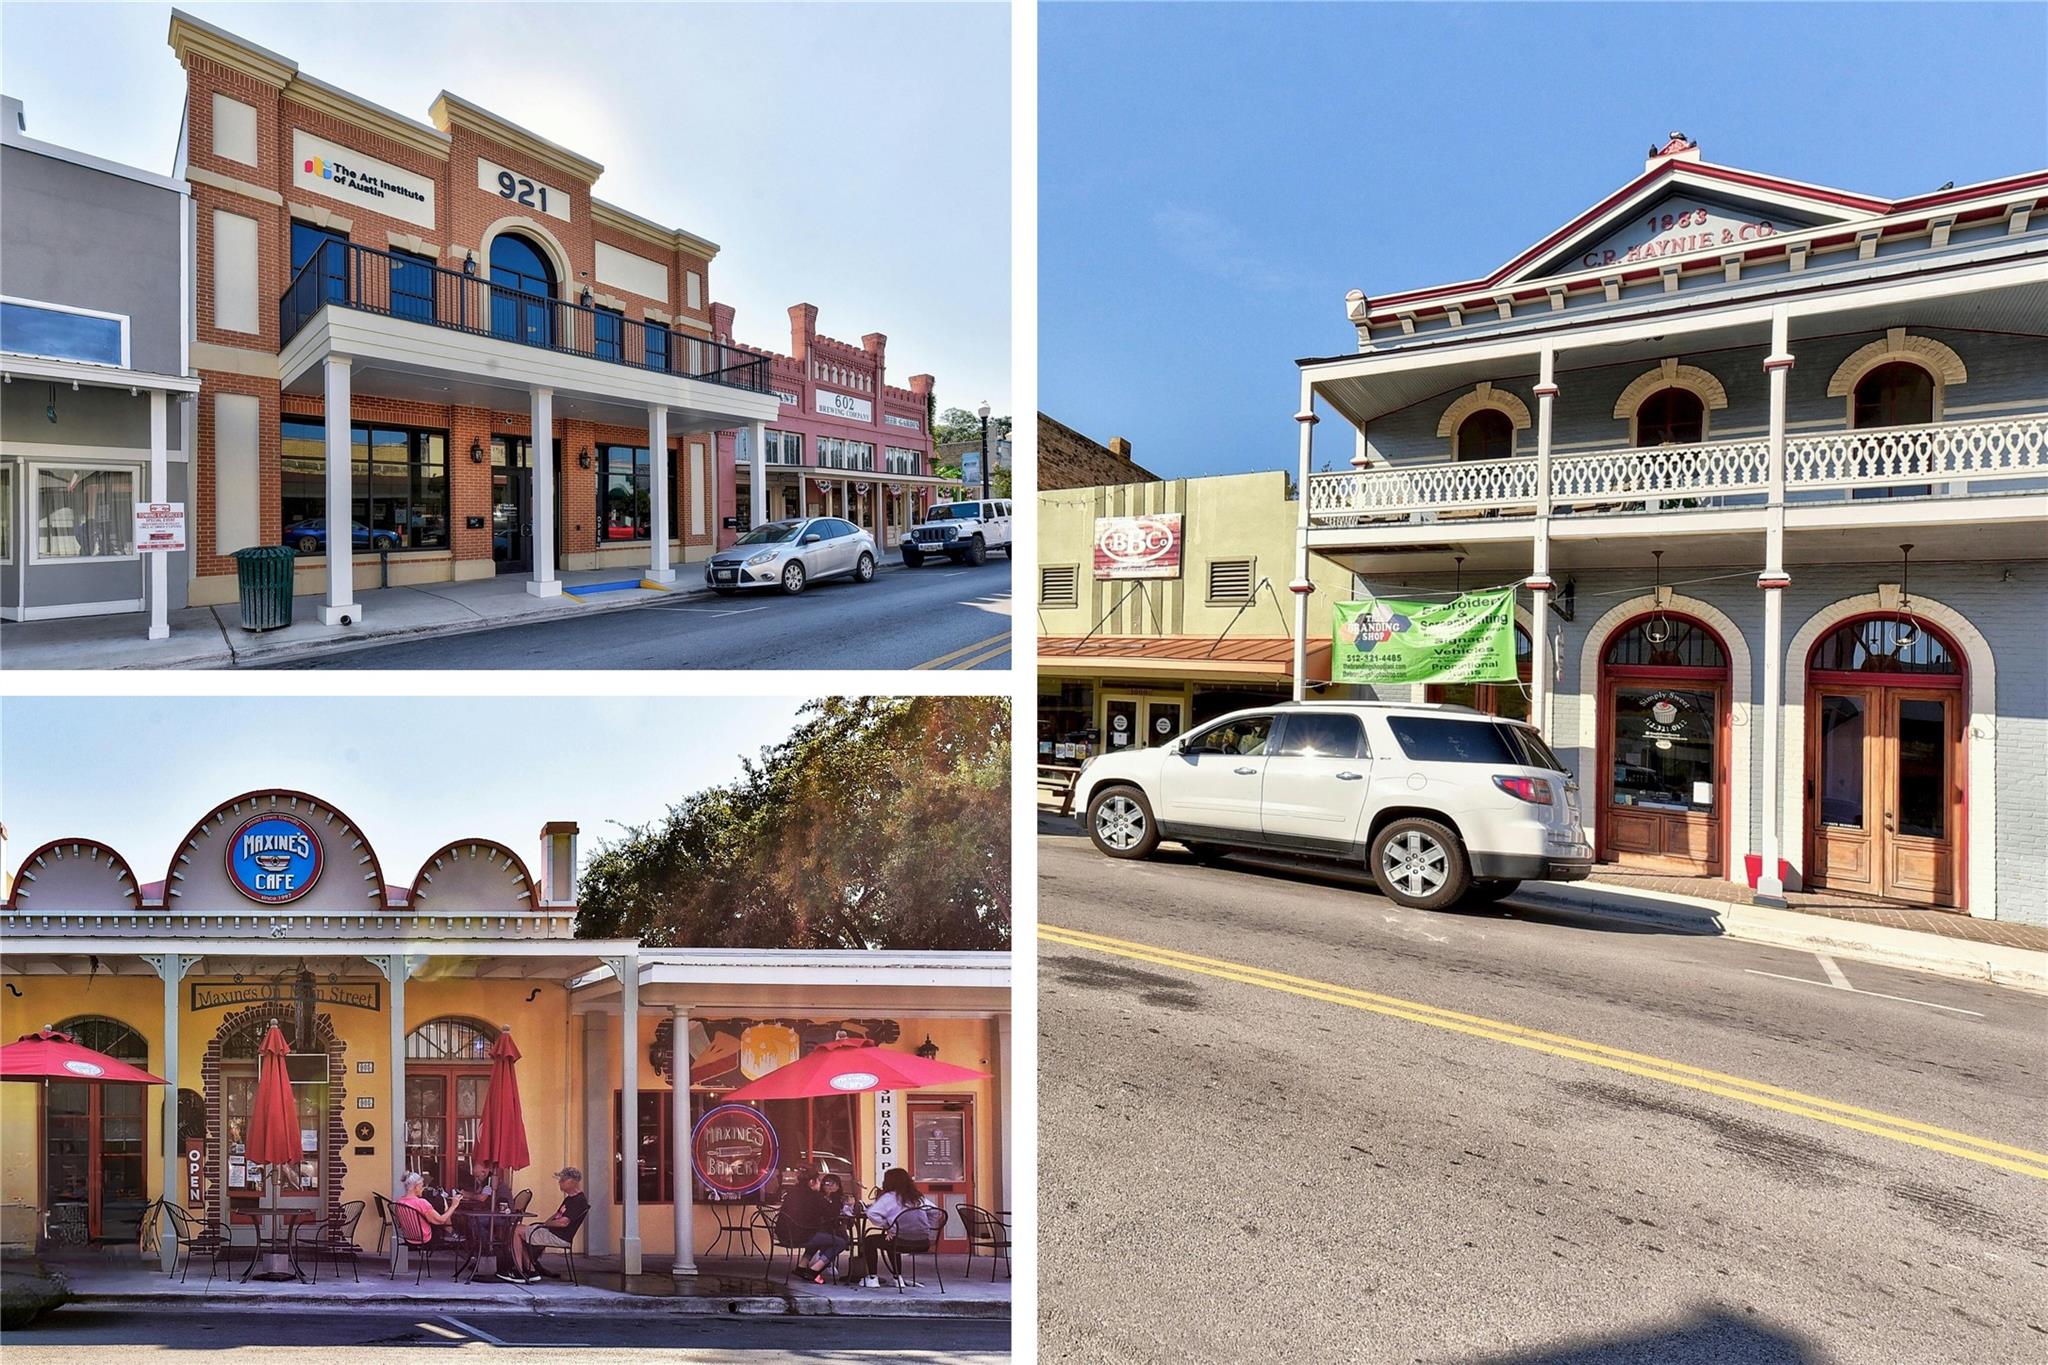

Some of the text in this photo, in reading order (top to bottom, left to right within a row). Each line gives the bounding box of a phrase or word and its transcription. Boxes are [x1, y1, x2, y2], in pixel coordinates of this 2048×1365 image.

[333, 163, 425, 202] The Art Institute
[333, 175, 385, 198] of Austin
[498, 171, 547, 213] 921
[1627, 232, 1714, 261] HAYNIE
[1721, 228, 1734, 244] &
[819, 404, 870, 421] BREWING COMPANY
[835, 394, 854, 411] 602
[898, 418, 919, 428] GARDEN
[1362, 632, 1385, 641] SHOP
[1346, 654, 1402, 663] 512-321-4485
[1639, 691, 1690, 709] Simply Sweet
[244, 832, 309, 860] MAXINE'S
[256, 874, 295, 889] CAFE
[330, 986, 372, 1007] Street
[705, 1125, 764, 1148] MAXINE'S
[881, 1110, 891, 1155] BAKED
[188, 1149, 201, 1201] OPEN
[707, 1157, 760, 1176] BAKERY
